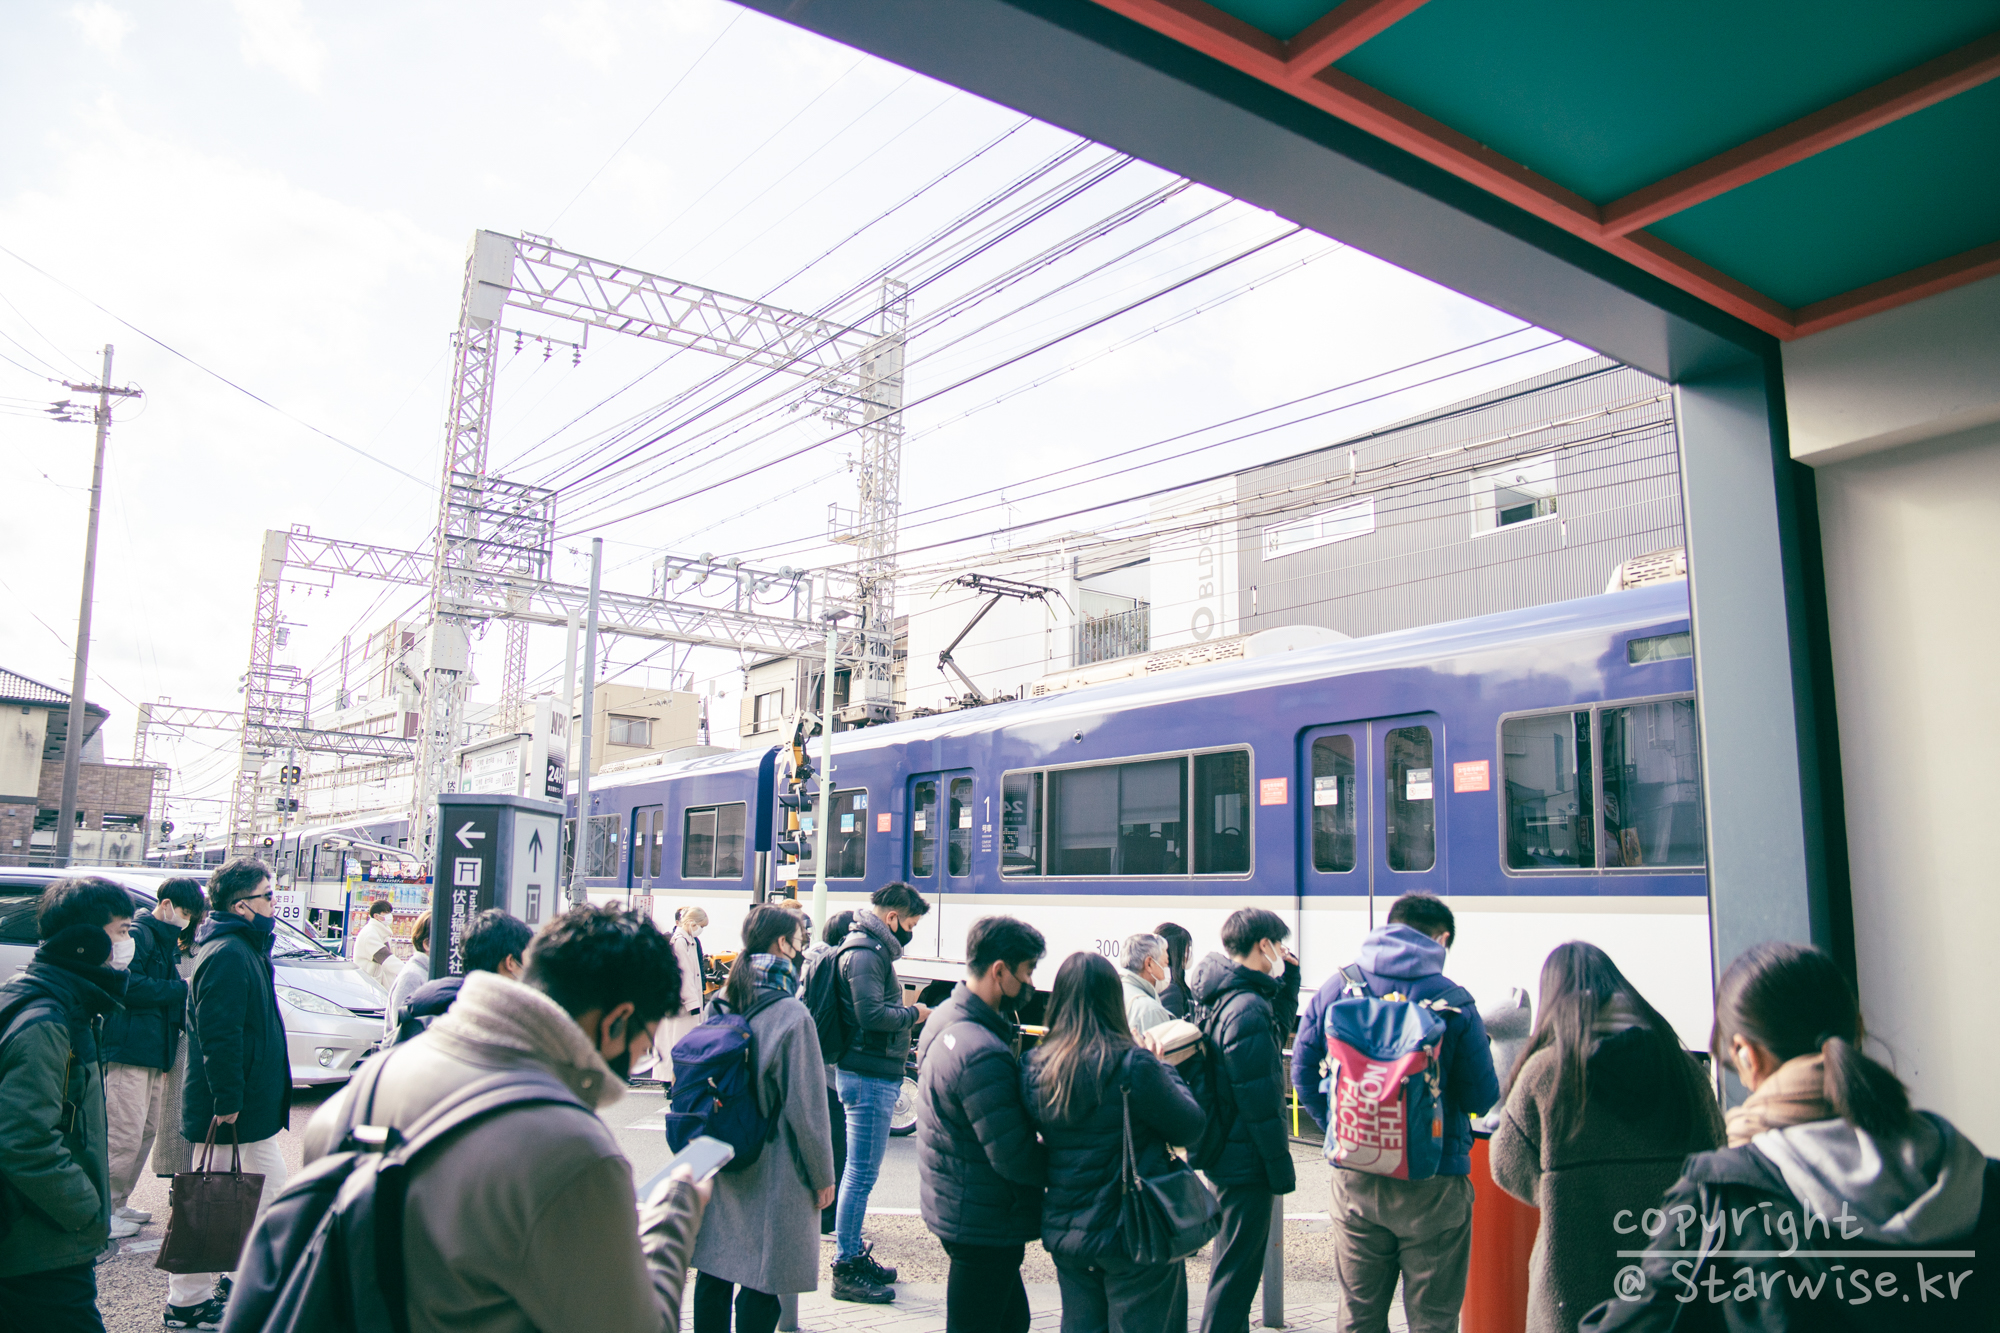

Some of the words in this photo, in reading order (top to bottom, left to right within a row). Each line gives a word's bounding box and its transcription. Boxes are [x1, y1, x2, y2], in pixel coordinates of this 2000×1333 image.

[551, 710, 567, 738] NPC
[547, 765, 564, 785] 24H
[984, 796, 990, 823] 1
[622, 827, 628, 844] 2
[449, 889, 467, 975] 伏見稲荷大社
[1340, 1076, 1359, 1142] FACE
[1358, 1063, 1388, 1147] NORTH
[1379, 1101, 1402, 1148] THE
